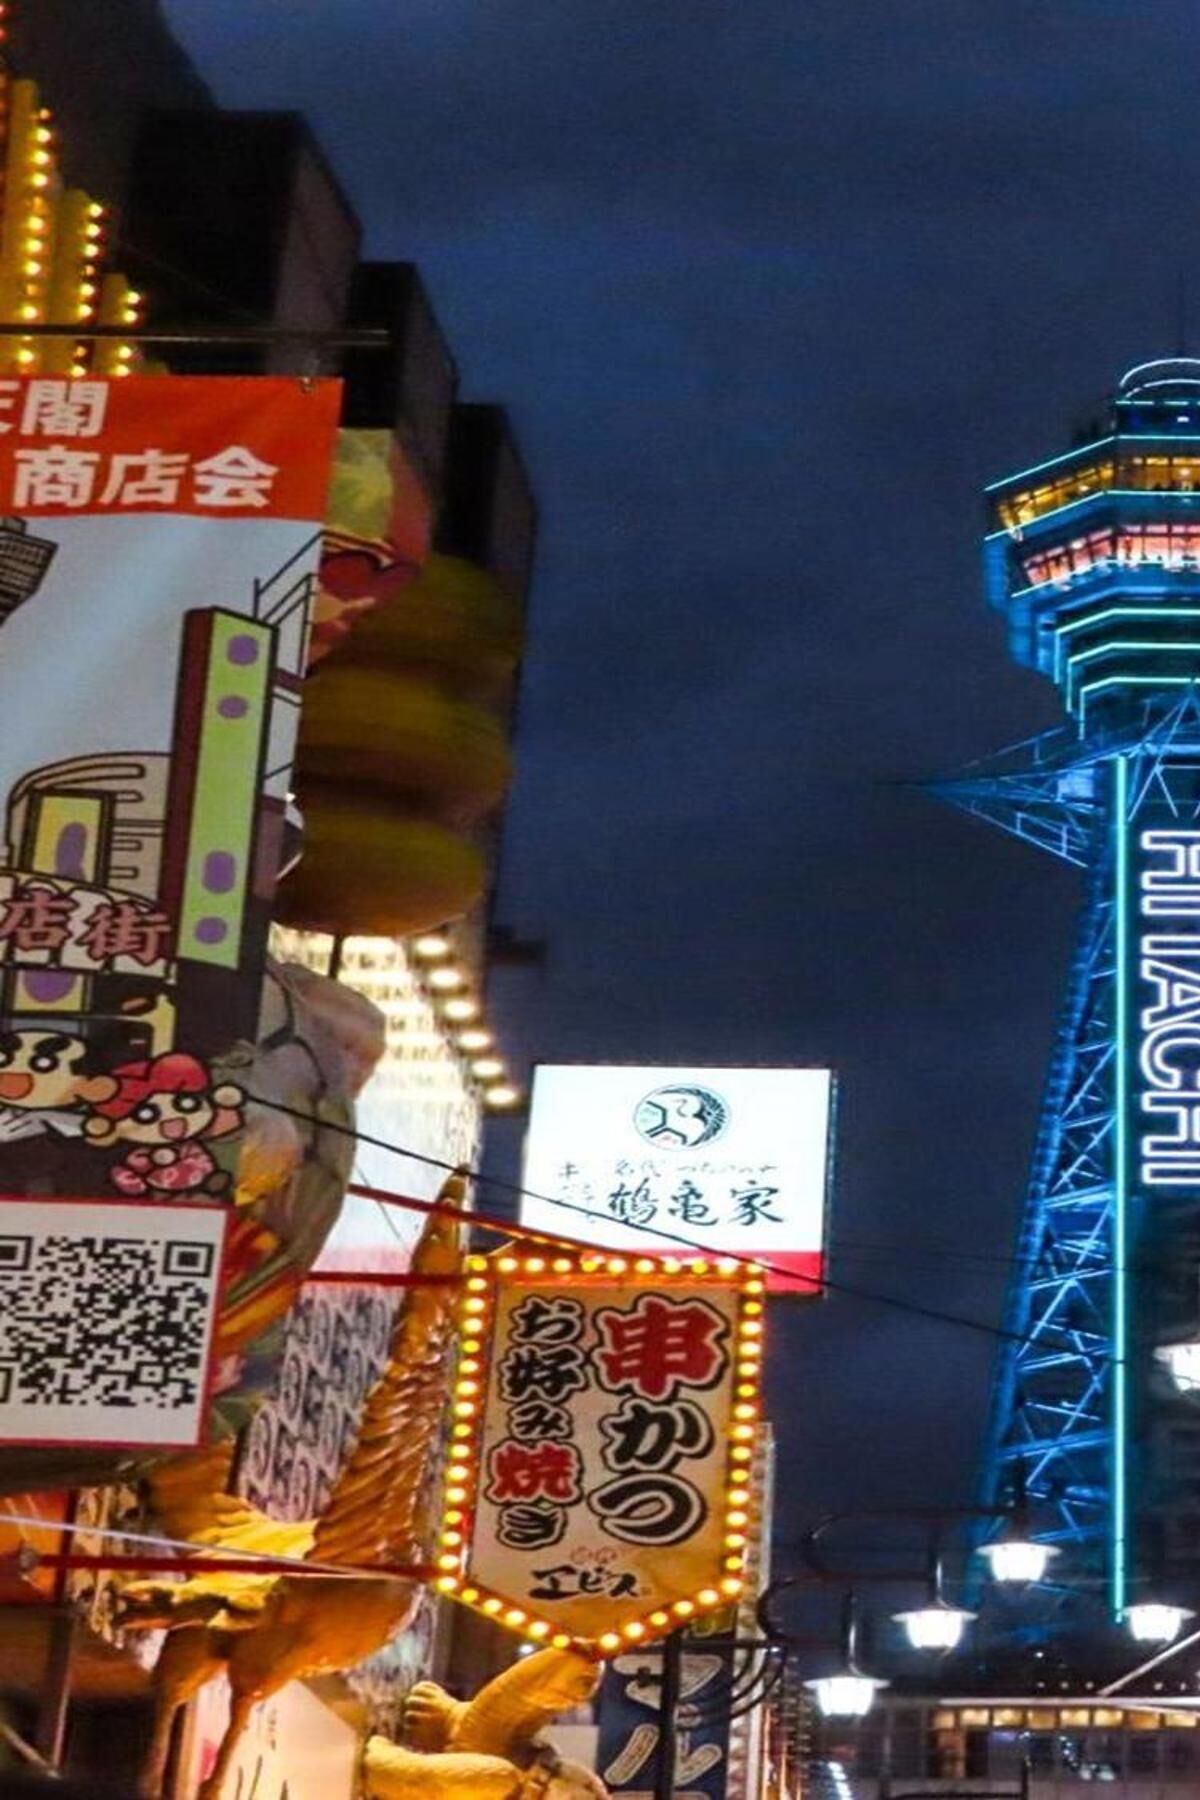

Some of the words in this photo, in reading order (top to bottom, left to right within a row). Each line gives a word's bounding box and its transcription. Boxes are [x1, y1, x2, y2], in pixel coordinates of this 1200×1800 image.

[0, 381, 109, 436] 閣
[12, 446, 279, 508] 商店会
[0, 886, 172, 966] 店街
[607, 1178, 785, 1226] 鶴亀家
[485, 1297, 588, 1549] お好み焼き
[589, 1291, 730, 1545] 串かつ
[528, 1564, 640, 1600] エビス
